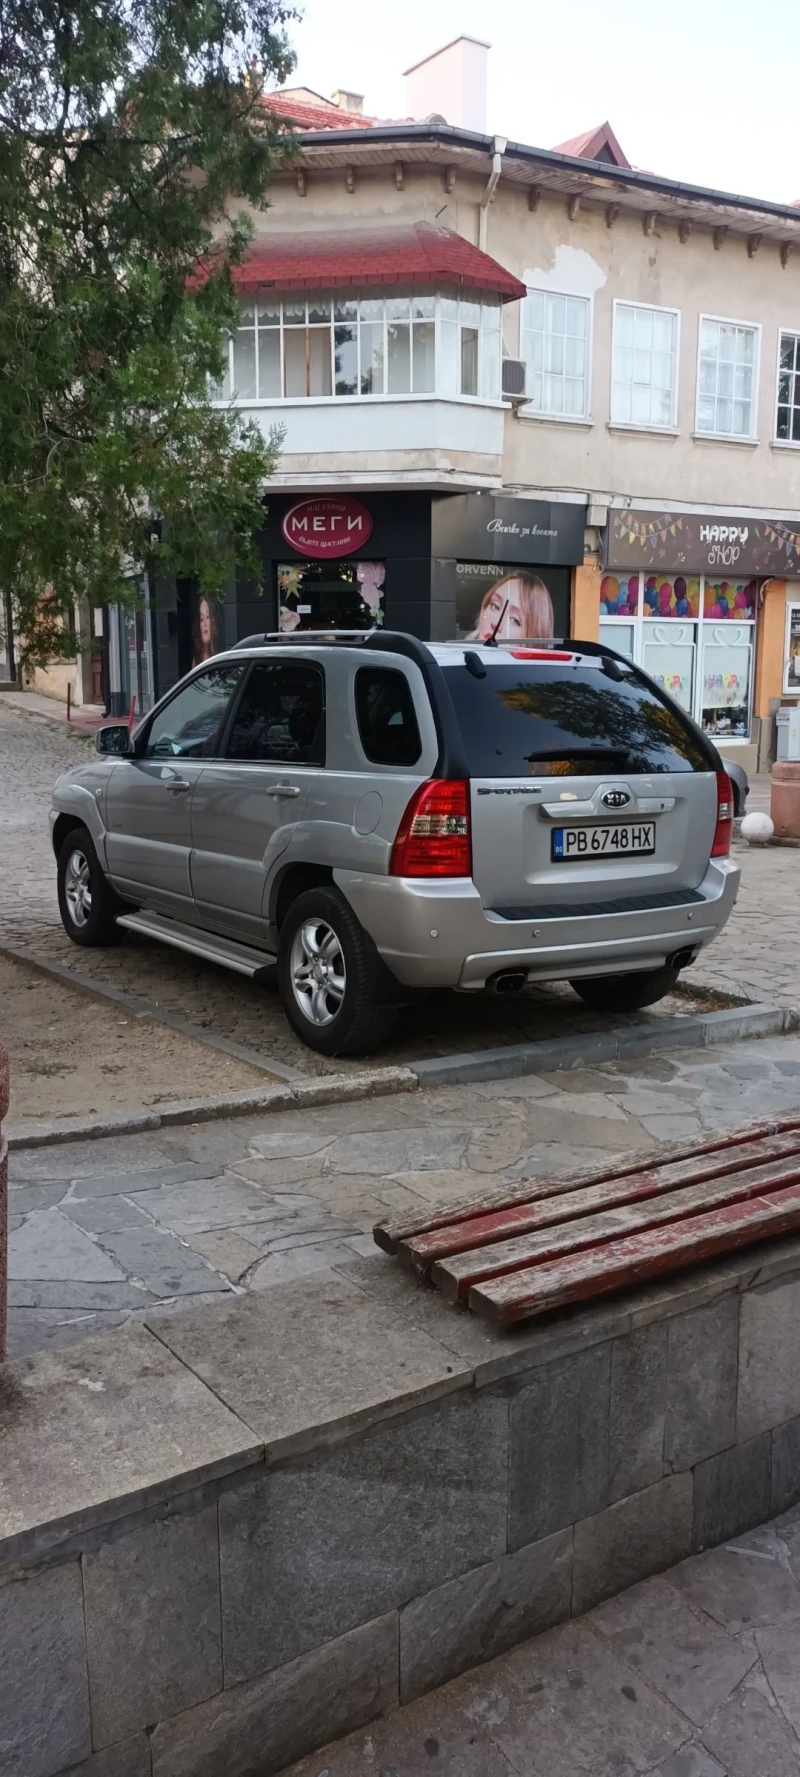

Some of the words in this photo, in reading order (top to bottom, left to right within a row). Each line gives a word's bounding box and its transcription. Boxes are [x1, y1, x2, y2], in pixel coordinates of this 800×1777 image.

[292, 516, 362, 531] МЕГИ
[486, 518, 520, 534] Всичко
[520, 527, 530, 538] за
[532, 524, 558, 536] косата
[700, 524, 749, 543] HAPPY
[708, 545, 740, 565] SHOP
[607, 793, 627, 804] KIA
[566, 831, 588, 853] PB
[591, 828, 629, 851] 6748
[632, 827, 651, 848] HX
